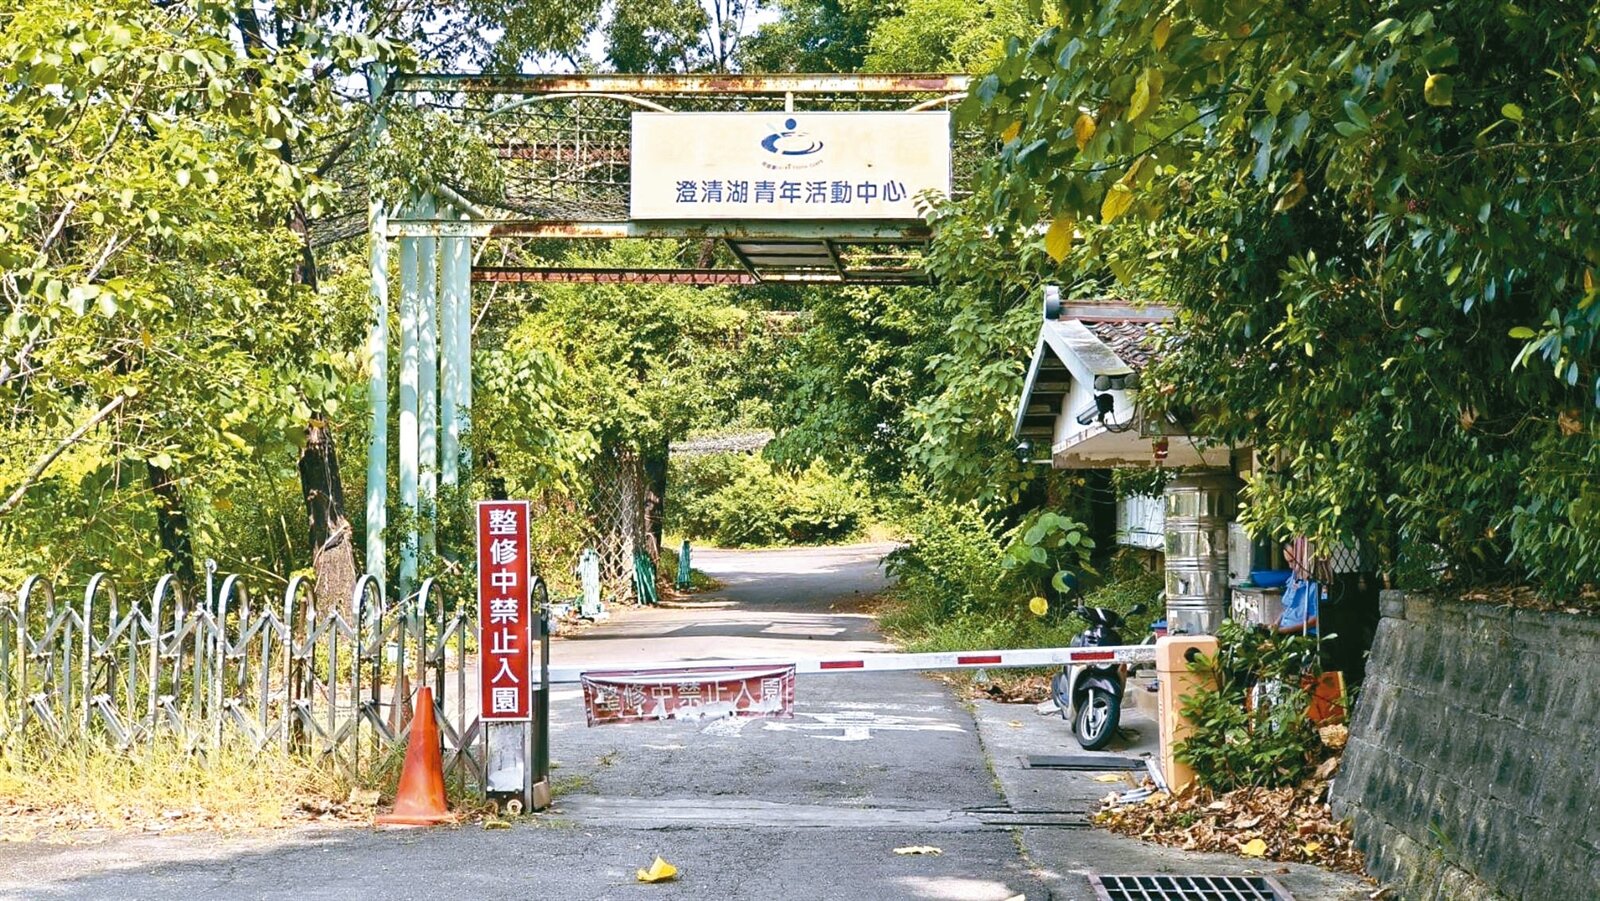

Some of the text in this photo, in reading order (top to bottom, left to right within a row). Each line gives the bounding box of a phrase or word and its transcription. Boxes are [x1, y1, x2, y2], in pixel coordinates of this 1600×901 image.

[675, 179, 907, 204] 澄清湖青年活動中心
[489, 509, 519, 713] 整修中禁止入園
